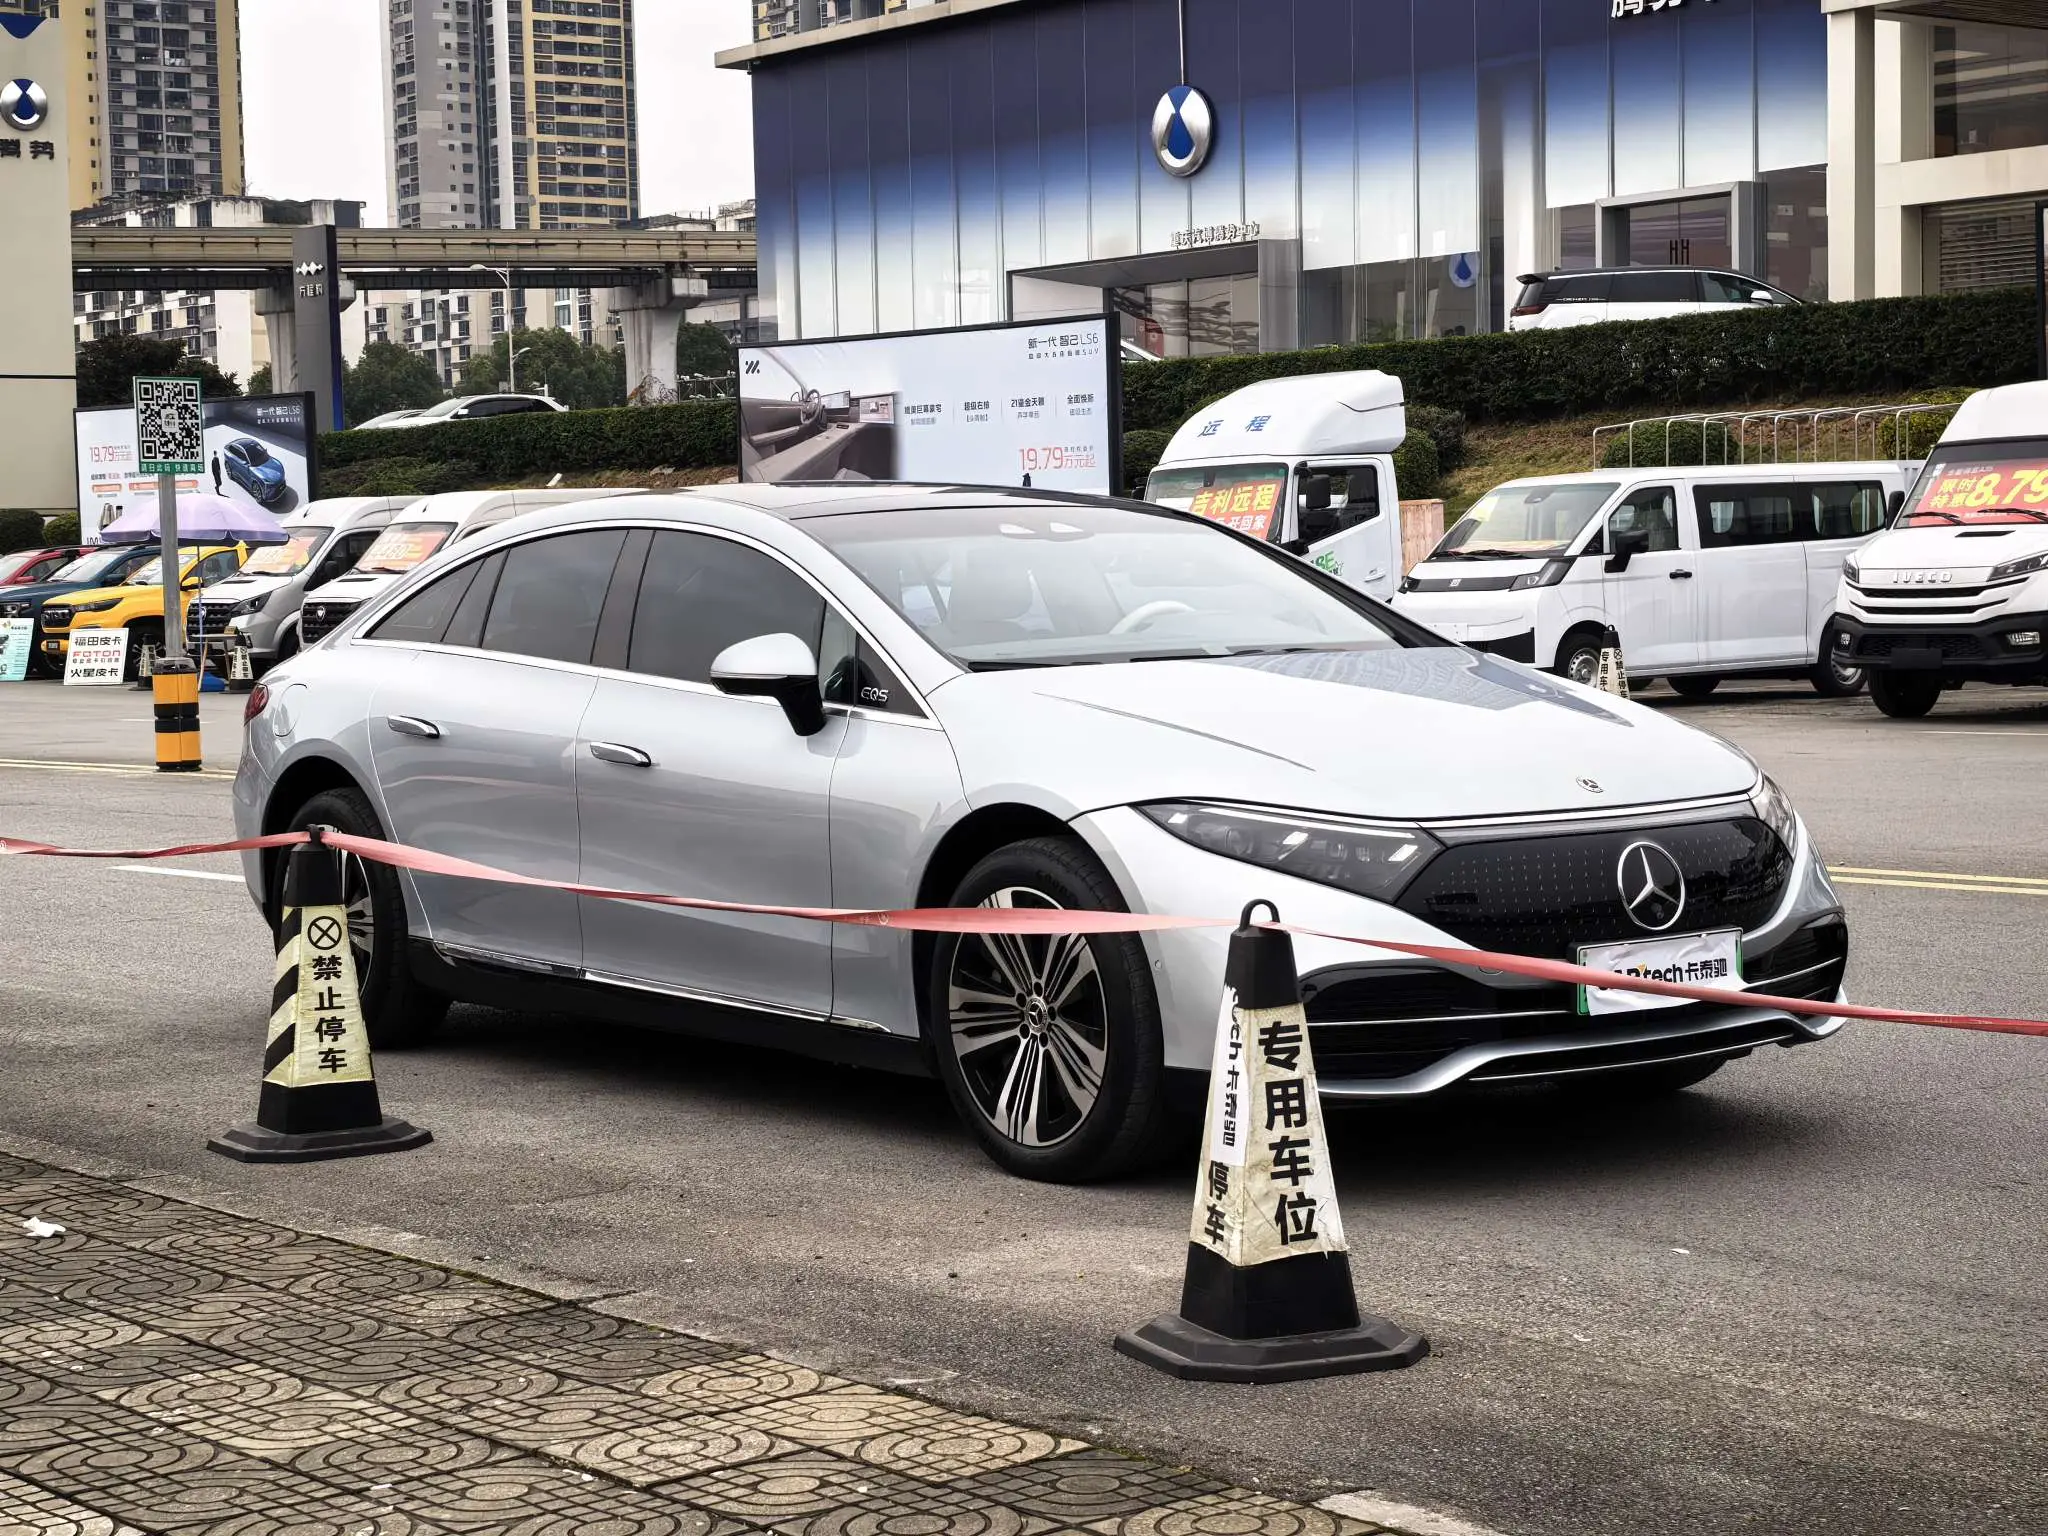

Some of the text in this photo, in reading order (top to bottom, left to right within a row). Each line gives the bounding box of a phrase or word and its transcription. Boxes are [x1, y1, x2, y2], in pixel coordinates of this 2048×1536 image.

[1197, 415, 1272, 437] 远程
[1191, 483, 1277, 516] 吉利远程
[1892, 569, 1953, 584] IVECO
[74, 636, 122, 646] 福田皮卡
[72, 650, 121, 658] FOTON
[70, 668, 119, 677] 火星皮卡
[861, 686, 889, 702] EQS
[312, 954, 348, 1073] 禁止停车
[1258, 1021, 1319, 1246] 专用车位
